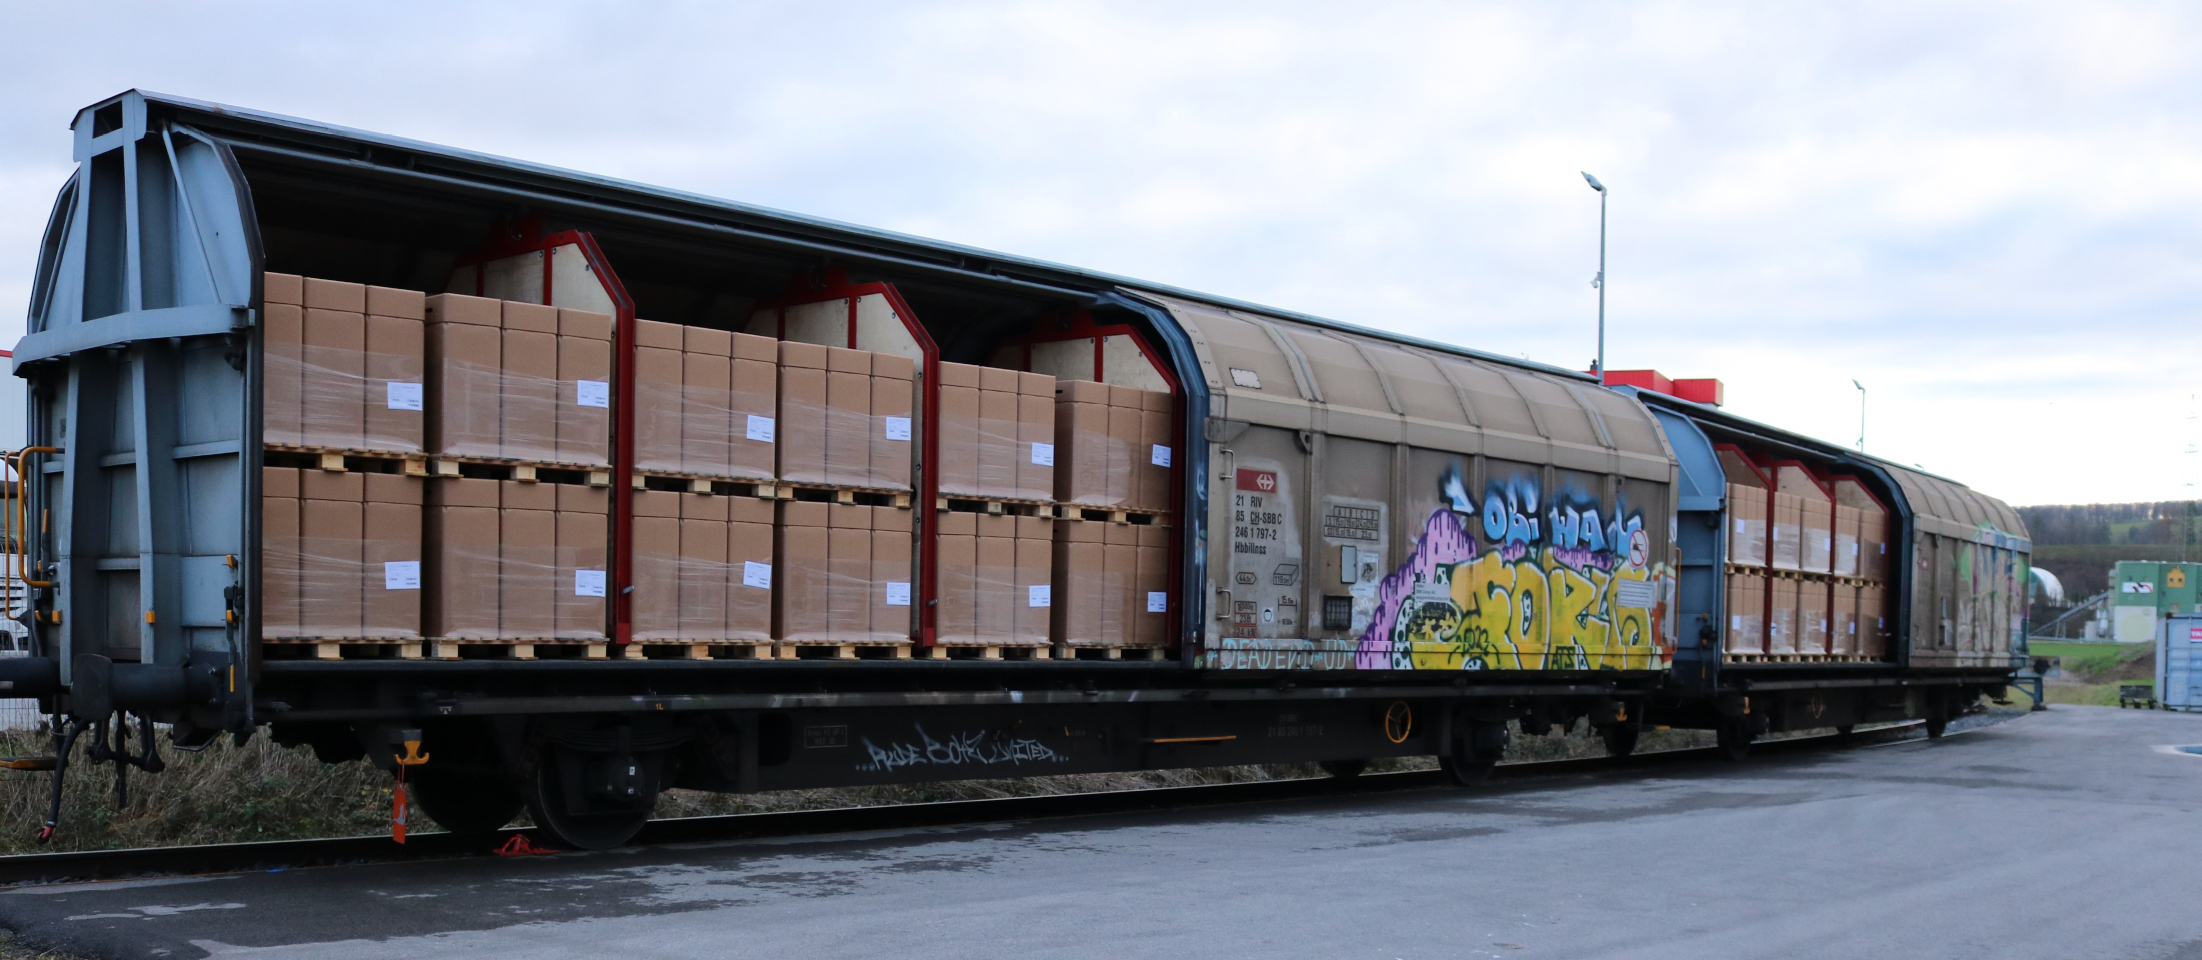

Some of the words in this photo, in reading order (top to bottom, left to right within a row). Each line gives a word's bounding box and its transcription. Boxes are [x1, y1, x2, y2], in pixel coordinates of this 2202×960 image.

[1236, 494, 1244, 506] 21
[1250, 496, 1262, 508] RIV
[1236, 510, 1244, 522] 85
[1235, 526, 1248, 538] 246
[1256, 527, 1277, 540] 797-2
[1236, 628, 1245, 637] 24
